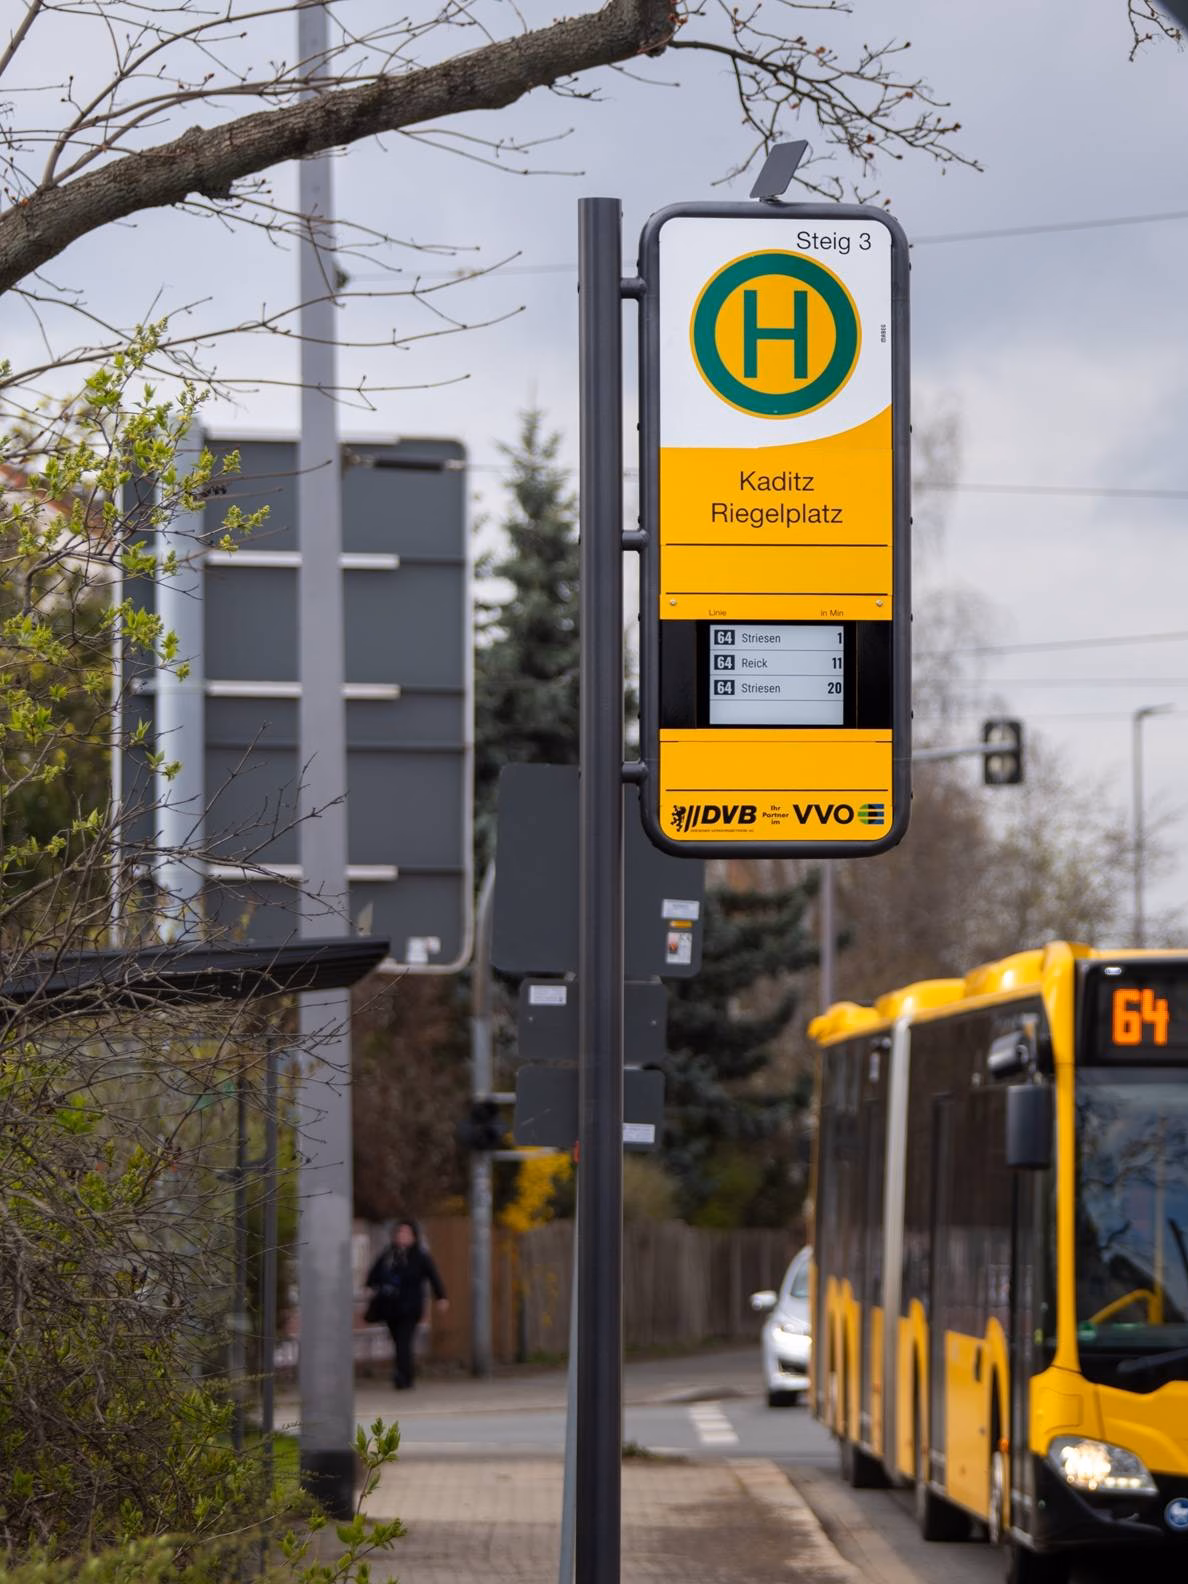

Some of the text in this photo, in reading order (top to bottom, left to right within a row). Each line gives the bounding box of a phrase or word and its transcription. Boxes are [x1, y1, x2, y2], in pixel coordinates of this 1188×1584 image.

[796, 231, 872, 254] Steig 3
[743, 290, 808, 379] H
[740, 471, 815, 491] Kaditz
[712, 503, 843, 528] Riegelplatz
[709, 609, 727, 617] Linie
[717, 631, 842, 644] 64 Striesen 1
[717, 656, 842, 669] 64 Reick 11
[717, 681, 842, 694] 64 Striesen 20
[701, 805, 757, 824] DVB
[793, 804, 854, 824] VVO
[1112, 988, 1168, 1046] 64
